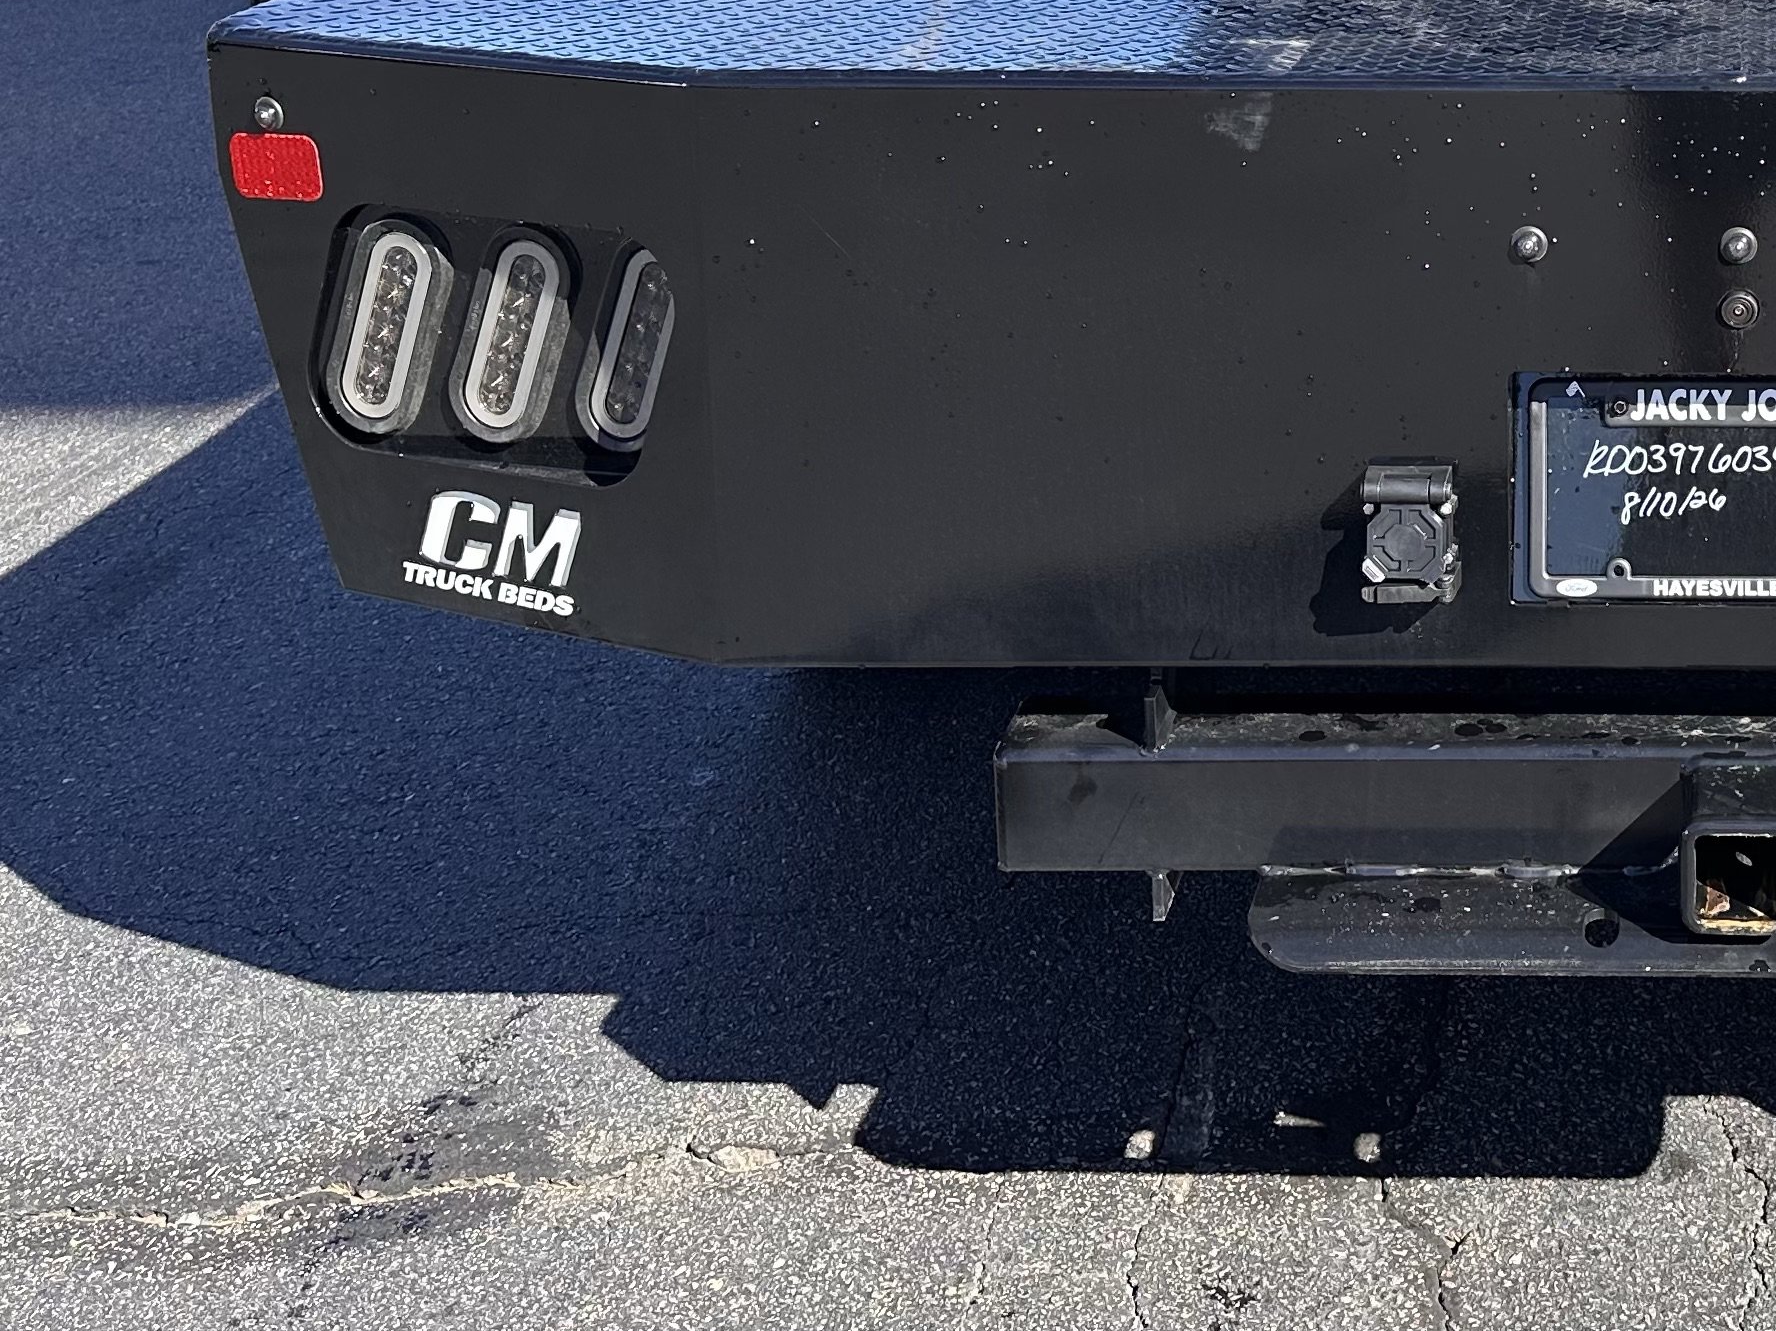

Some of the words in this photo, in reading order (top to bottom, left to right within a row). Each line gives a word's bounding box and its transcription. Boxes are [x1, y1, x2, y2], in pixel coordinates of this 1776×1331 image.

[1630, 388, 1733, 422] JACKY
[1620, 486, 1727, 526] 8/10/26
[418, 490, 582, 588] CM
[402, 560, 494, 600] TRUCK
[497, 582, 575, 617] BEDS
